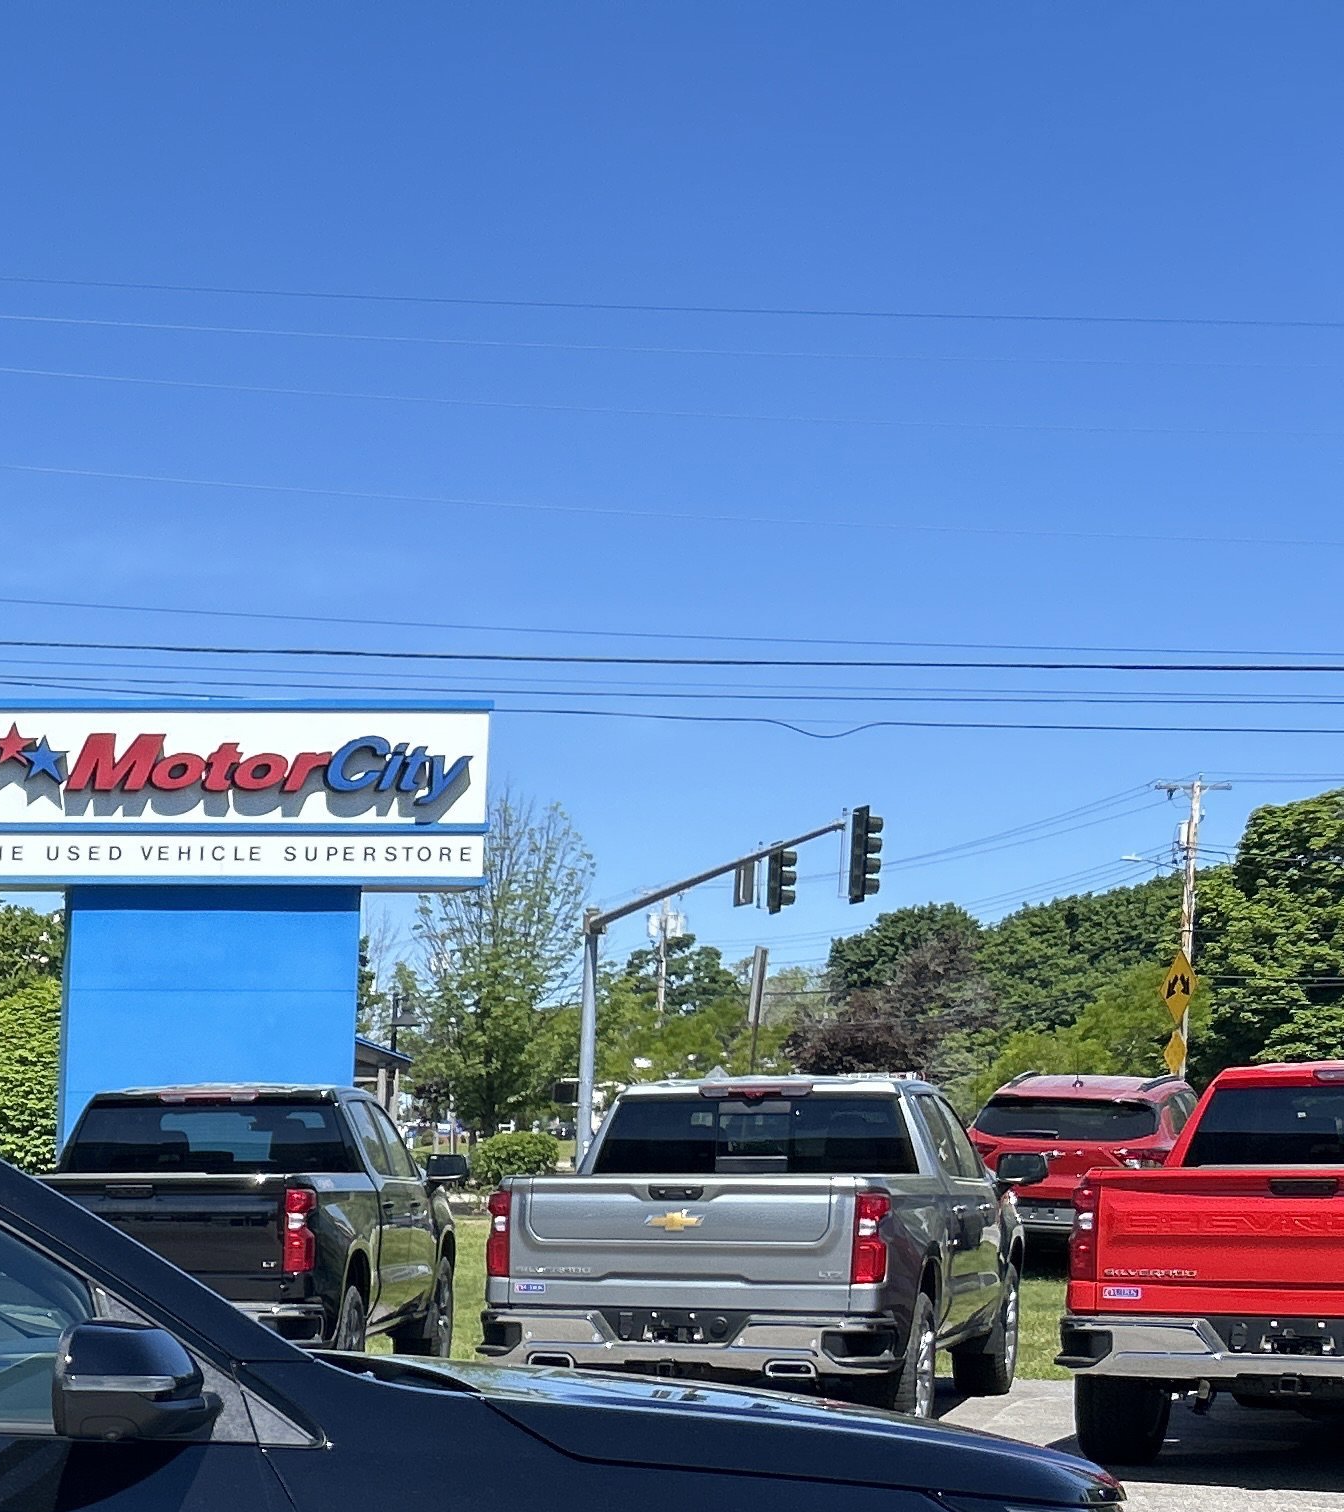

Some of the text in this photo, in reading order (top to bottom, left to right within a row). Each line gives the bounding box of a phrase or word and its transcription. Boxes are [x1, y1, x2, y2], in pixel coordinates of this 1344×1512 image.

[63, 733, 474, 808] MotorCity
[46, 845, 122, 861] USED
[140, 845, 262, 861] VEHICLE
[283, 845, 472, 862] SUPERSTORE
